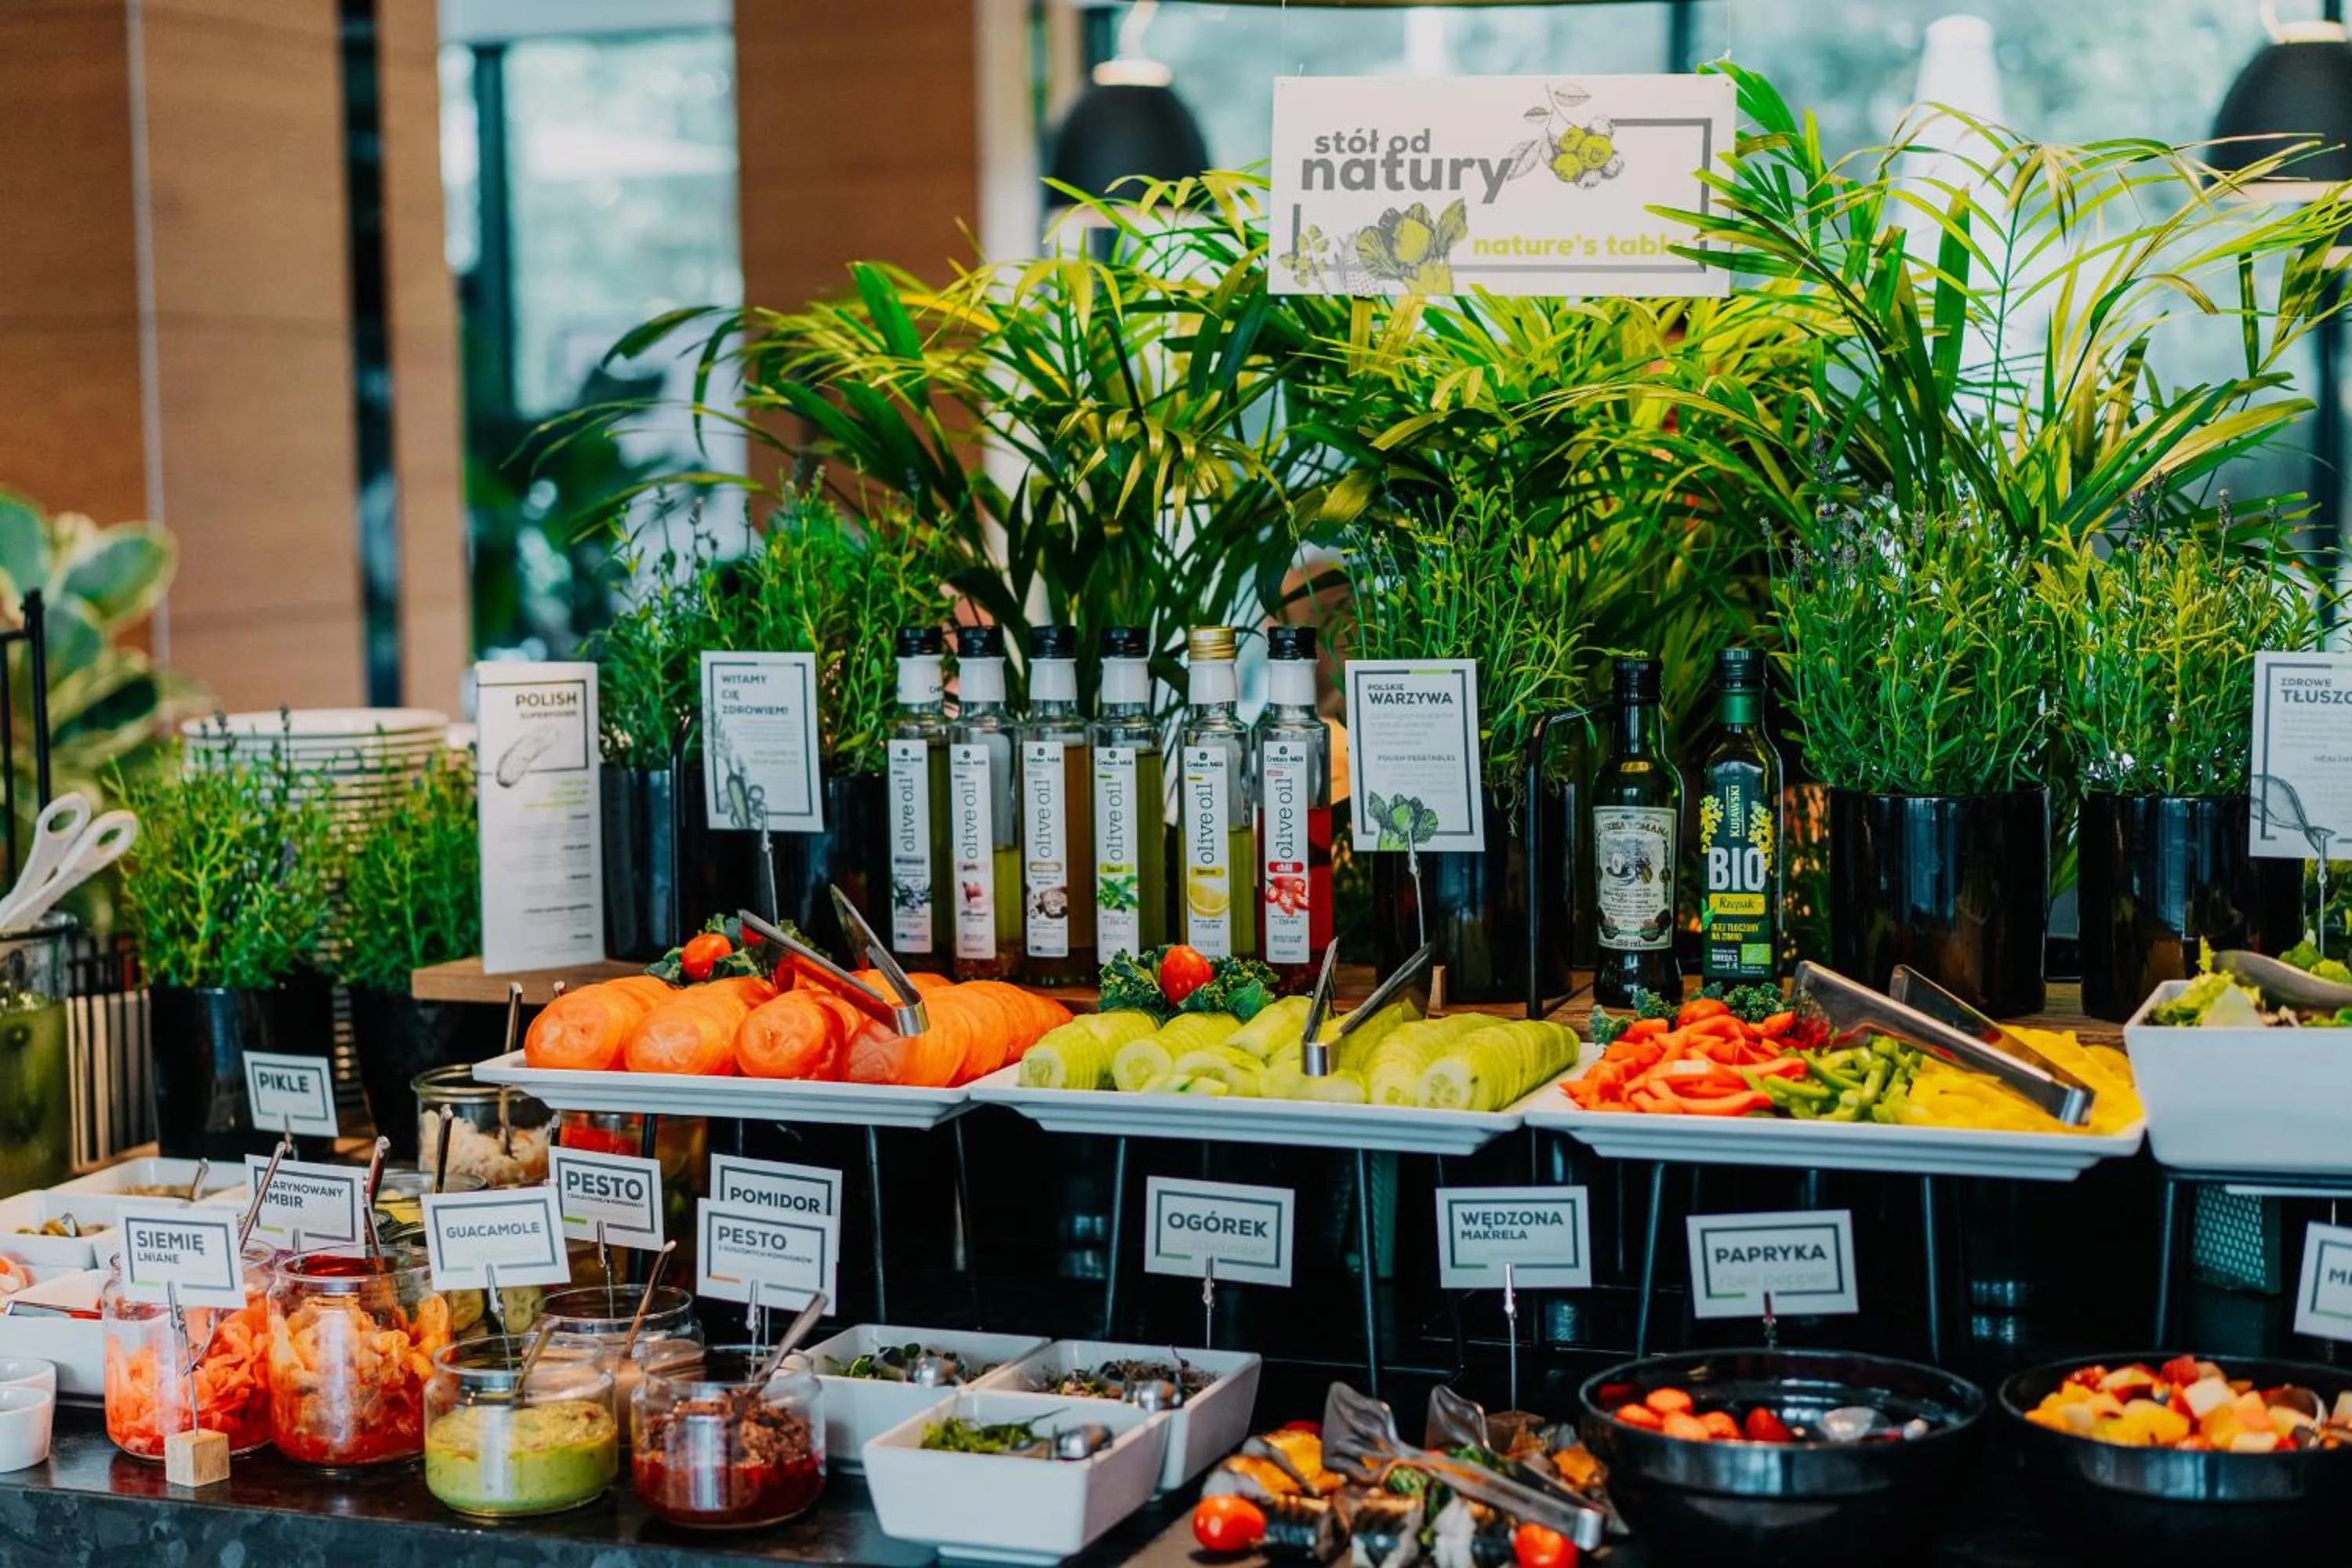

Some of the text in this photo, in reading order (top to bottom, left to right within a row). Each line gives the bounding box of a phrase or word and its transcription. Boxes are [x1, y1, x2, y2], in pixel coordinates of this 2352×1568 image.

[1315, 129, 1432, 155] stół od
[1301, 151, 1515, 204] natury
[1473, 232, 1683, 257] nature's tabl
[721, 675, 768, 684] WITAMY
[2281, 678, 2332, 687] ZDROWE
[516, 691, 578, 707] POLISH
[722, 690, 739, 701] CIĘ
[1369, 692, 1453, 704] WARZYWA
[899, 778, 914, 801] oil
[1035, 779, 1051, 804] oil
[899, 805, 915, 851] olive
[963, 782, 978, 859] olive oil
[1106, 782, 1123, 862] olive oil
[1197, 783, 1214, 864] olive oil
[1276, 778, 1294, 859] olive oil
[1036, 807, 1052, 858] olive
[1708, 847, 1766, 891] BIO
[259, 1072, 310, 1094] PIKLE
[269, 1179, 343, 1198] ARYNOWANY
[566, 1171, 644, 1200] PESTO
[730, 1186, 821, 1213] POMIDOR
[446, 1221, 541, 1239] GUACAMOLE
[1167, 1210, 1269, 1238] OGÓREK
[1461, 1211, 1564, 1228] WĘDZONA
[136, 1230, 205, 1255] SIEMIĘ
[718, 1225, 787, 1250] PESTO
[1461, 1230, 1528, 1240] MAKRELA
[137, 1252, 180, 1265] LNIANE
[1715, 1243, 1828, 1264] PAPRYKA
